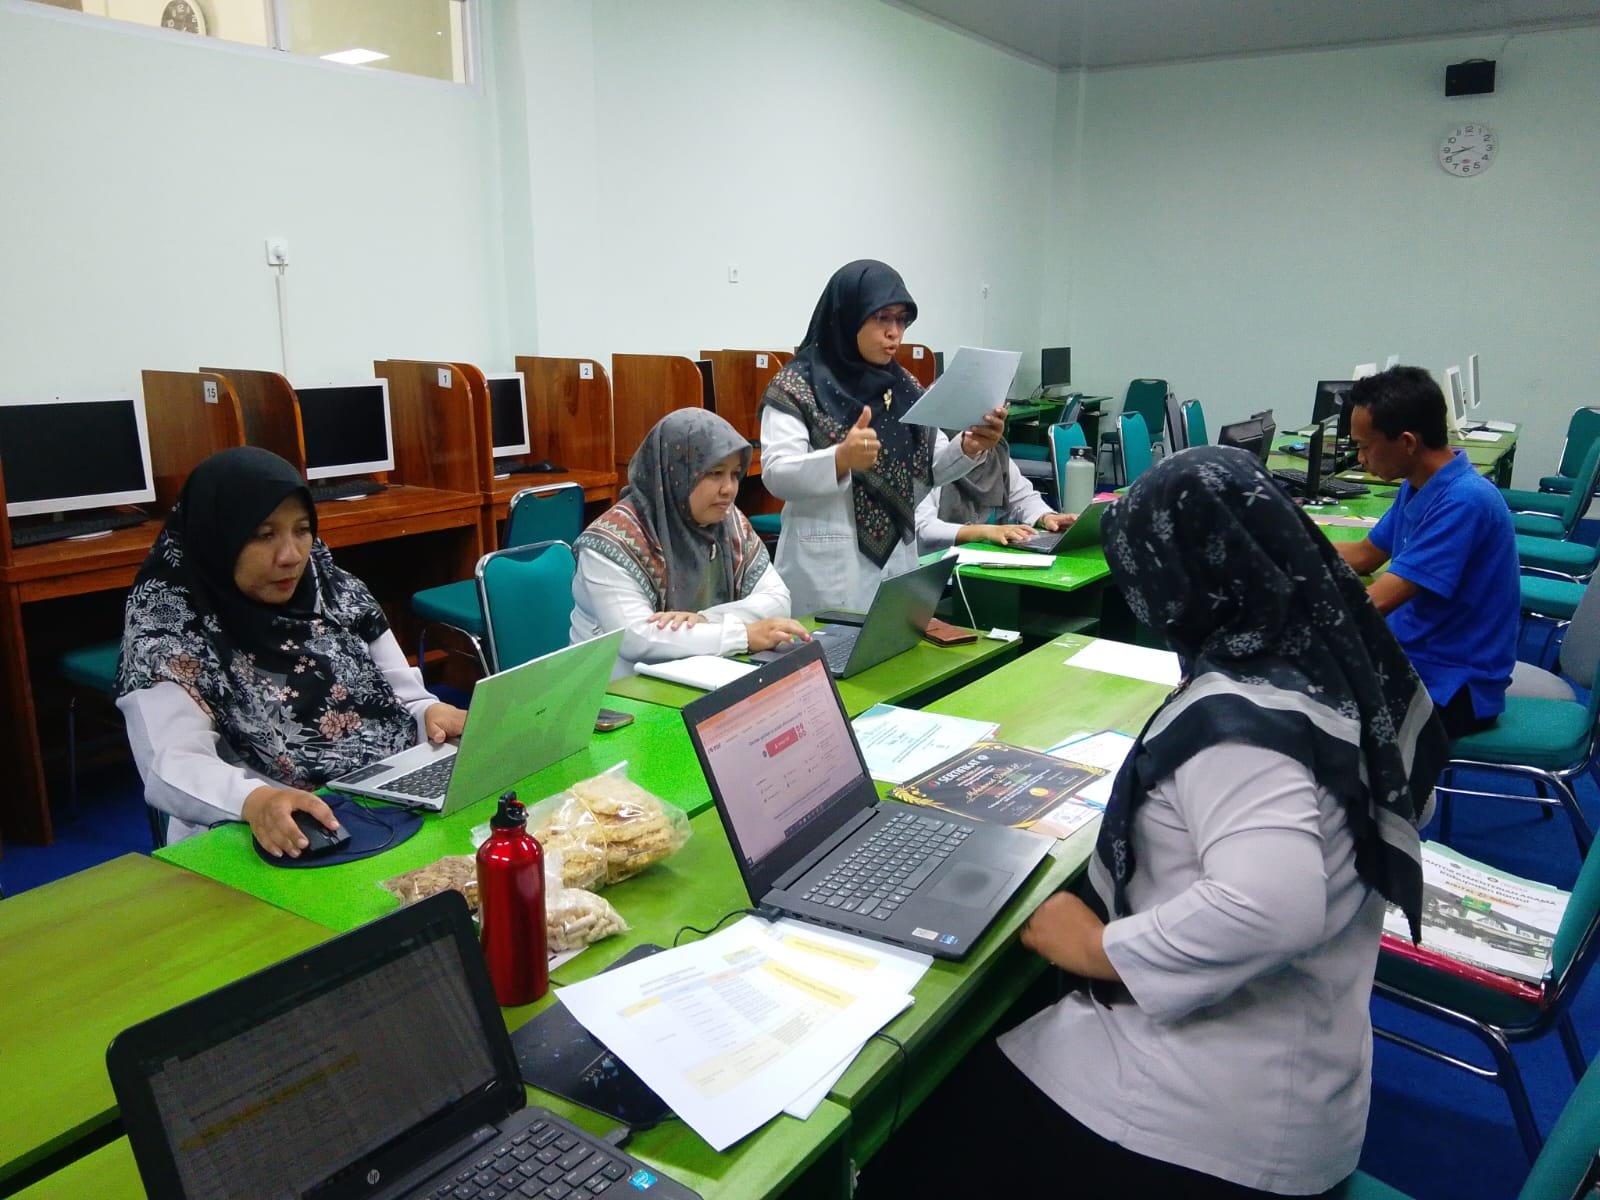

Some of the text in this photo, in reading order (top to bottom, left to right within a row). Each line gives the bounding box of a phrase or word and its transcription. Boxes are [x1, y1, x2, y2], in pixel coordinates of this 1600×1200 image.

[206, 387, 216, 399] 15
[937, 758, 982, 783] SERTIFIKAT
[1422, 858, 1455, 873] ANTOR
[1440, 870, 1494, 893] Kabupaten
[1495, 890, 1529, 904] Bantul
